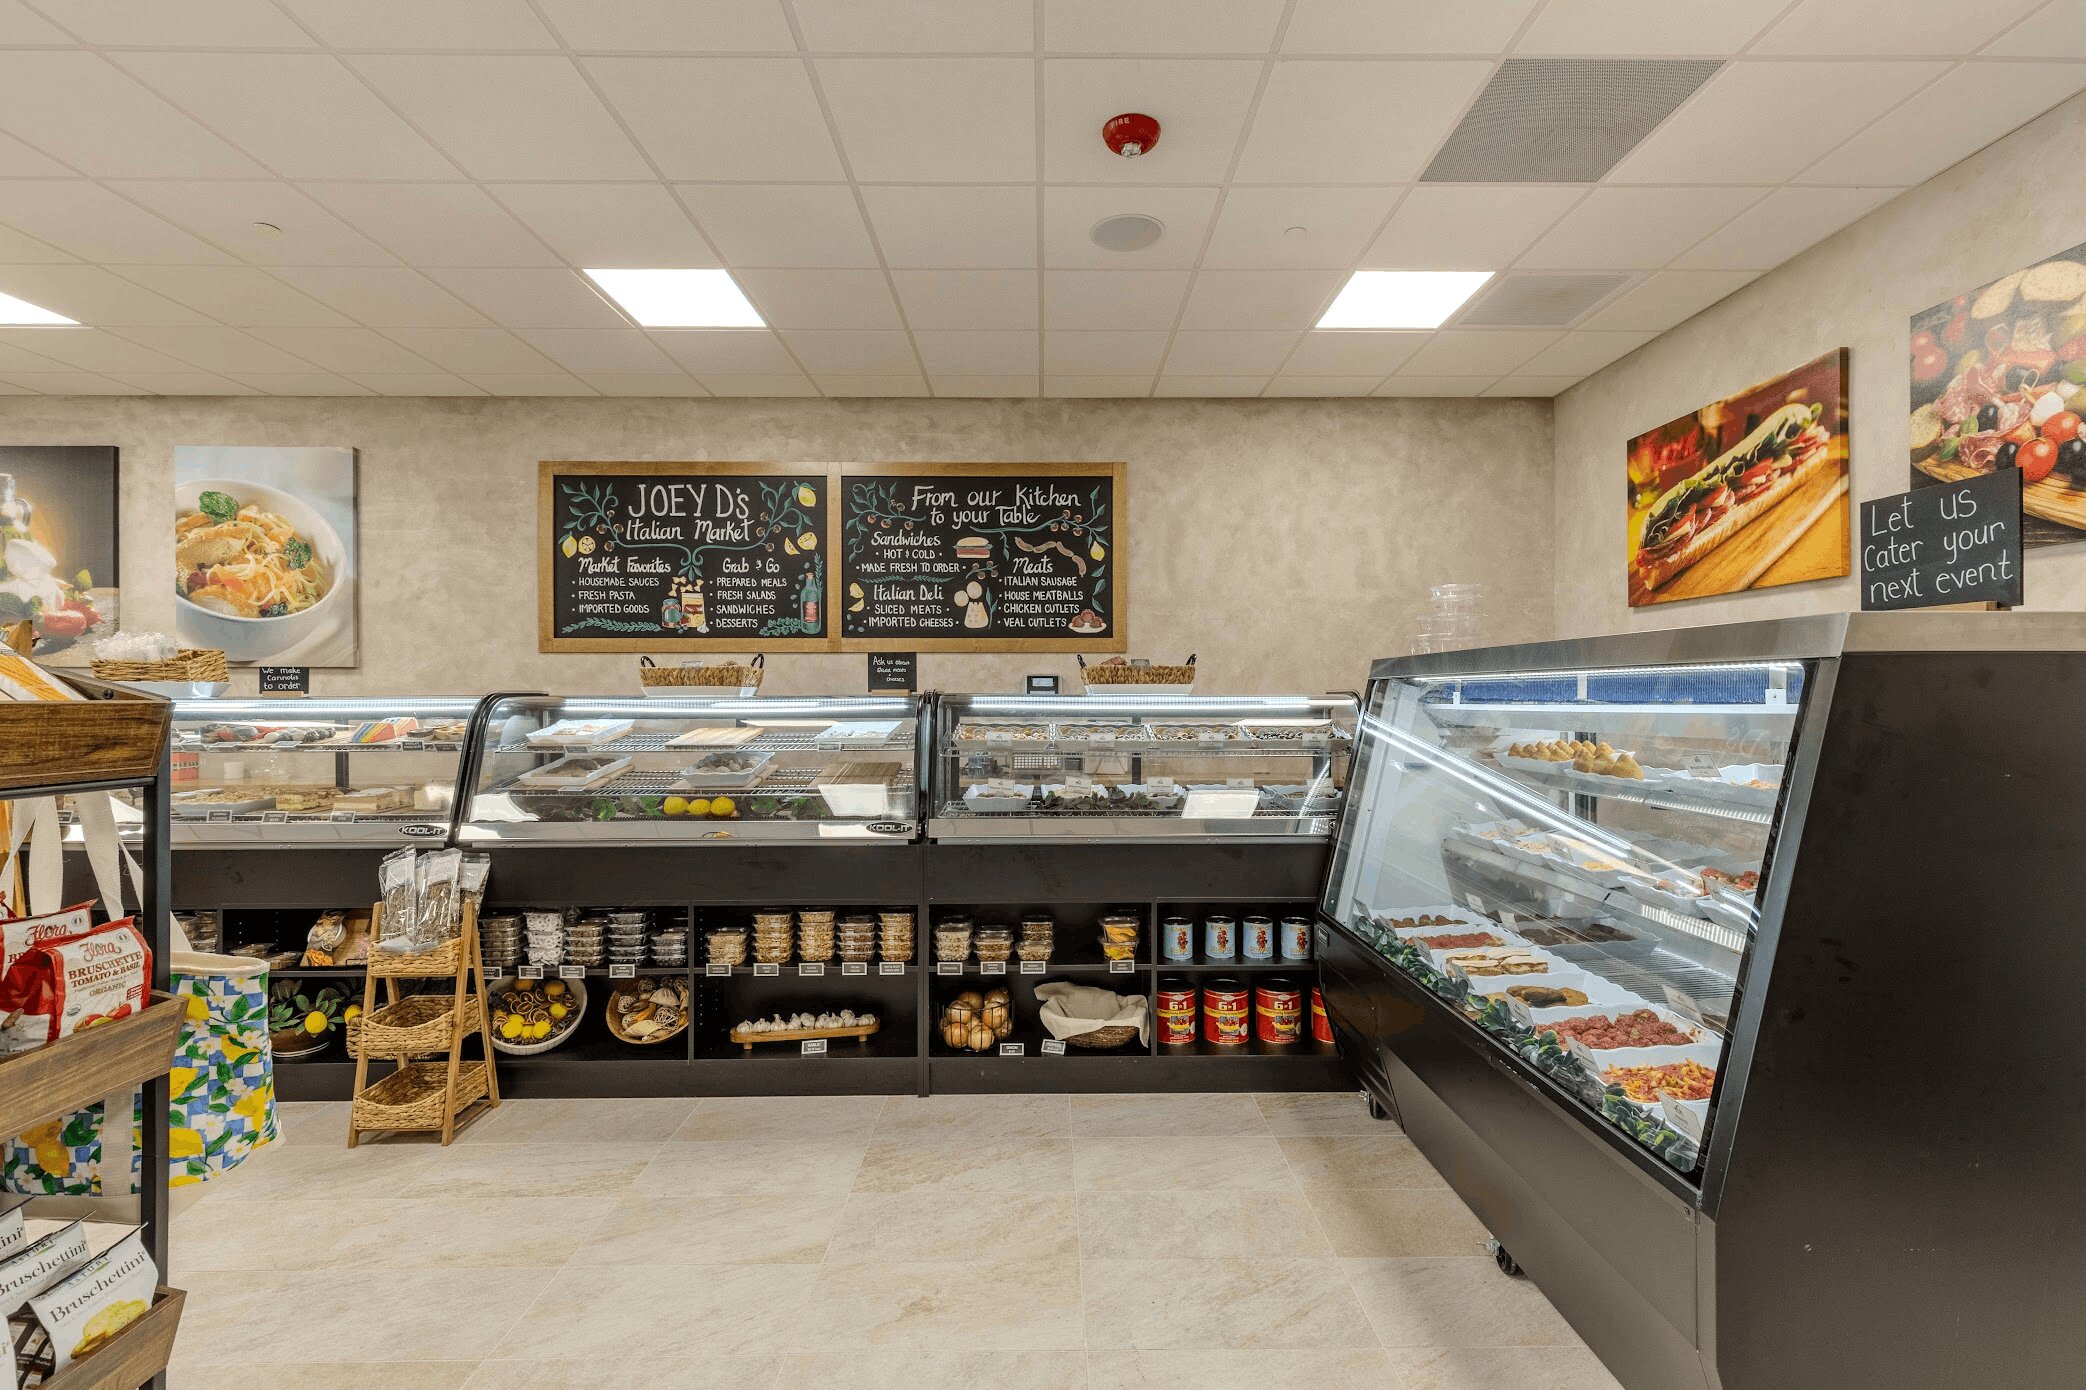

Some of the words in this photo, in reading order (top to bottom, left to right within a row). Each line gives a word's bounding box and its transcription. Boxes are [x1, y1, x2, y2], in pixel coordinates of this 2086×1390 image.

[1109, 116, 1131, 128] FIRE
[628, 484, 707, 518] JOEY
[716, 484, 750, 519] D's
[912, 485, 958, 511] From
[967, 489, 1002, 506] our
[1016, 484, 1081, 507] Kitchen
[930, 507, 944, 526] to
[952, 510, 991, 529] your
[996, 506, 1040, 526] Table
[1872, 496, 1914, 536] Let
[626, 519, 684, 541] Italian
[694, 518, 754, 542] Market
[871, 530, 941, 547] Sandwiches
[1944, 522, 2005, 564] your
[883, 549, 903, 558] HOT
[912, 549, 936, 558] COLD
[578, 557, 619, 573] Market
[626, 557, 672, 573] Favorites
[722, 558, 750, 573] Grab
[766, 558, 780, 573] Go
[861, 563, 887, 573] MADE
[890, 563, 918, 573] FRESH
[921, 561, 930, 573] TO
[932, 563, 960, 573] ORDER
[1012, 556, 1054, 574] Meats
[578, 577, 626, 586] HOUSEMADE
[628, 577, 660, 586] SAUCES
[716, 577, 758, 587] PREPARED
[761, 577, 787, 587] MEALS
[1004, 576, 1038, 586] ITALIAN
[1040, 576, 1077, 586] SAUSAGE
[1870, 568, 1923, 603] next
[1936, 549, 2013, 593] event
[578, 590, 606, 600] FRESH
[609, 590, 635, 600] PASTA
[717, 590, 743, 600] FRESH
[746, 590, 776, 600] SALADS
[874, 584, 914, 601] Italian
[920, 584, 944, 601] Deli
[1004, 590, 1030, 601] HOUSE
[1032, 590, 1084, 601] MEATBALLS
[579, 604, 621, 614] IMPORTED
[623, 604, 650, 614] GOODS
[716, 604, 775, 614] SANDWICHES
[874, 605, 905, 614] SLICED
[910, 605, 942, 614] MEATS
[1004, 603, 1042, 613] CHICKEN
[1044, 603, 1080, 613] CUTLETS
[716, 618, 758, 628] DESSERTS
[868, 617, 916, 627] IMPORTED
[919, 618, 954, 627] CHEESES
[1004, 617, 1025, 627] VEAL
[1028, 617, 1067, 627] CUTLETS
[873, 655, 886, 665] Ask
[263, 682, 274, 690] to
[278, 682, 301, 690] order
[67, 951, 143, 981] BRUSCHETTE
[71, 971, 111, 988] TOMATO
[49, 1251, 146, 1323] Bruschettini
